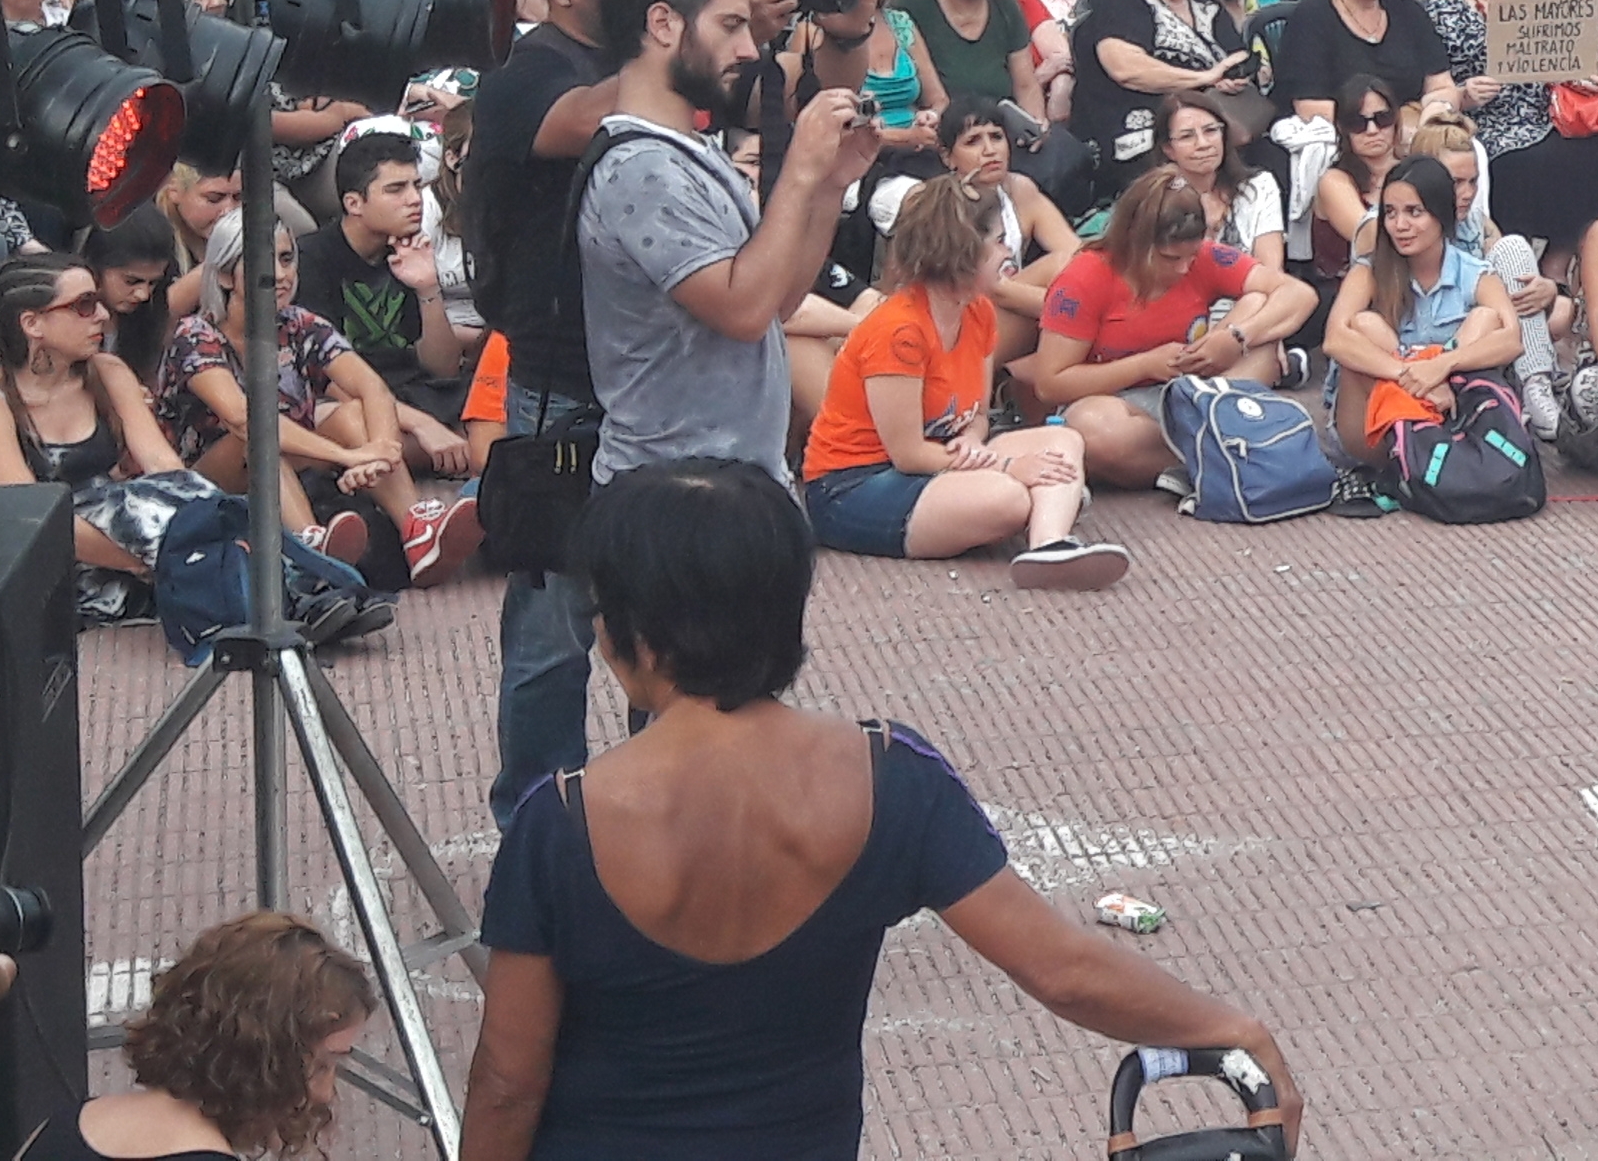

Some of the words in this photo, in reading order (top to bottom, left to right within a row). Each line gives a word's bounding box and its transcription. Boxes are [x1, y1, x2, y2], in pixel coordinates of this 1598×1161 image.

[1499, 4, 1527, 22] LAS
[1517, 23, 1581, 40] SUFRIMOS
[1506, 39, 1575, 55] MALTRATO
[1507, 53, 1581, 73] VIOLENCIA
